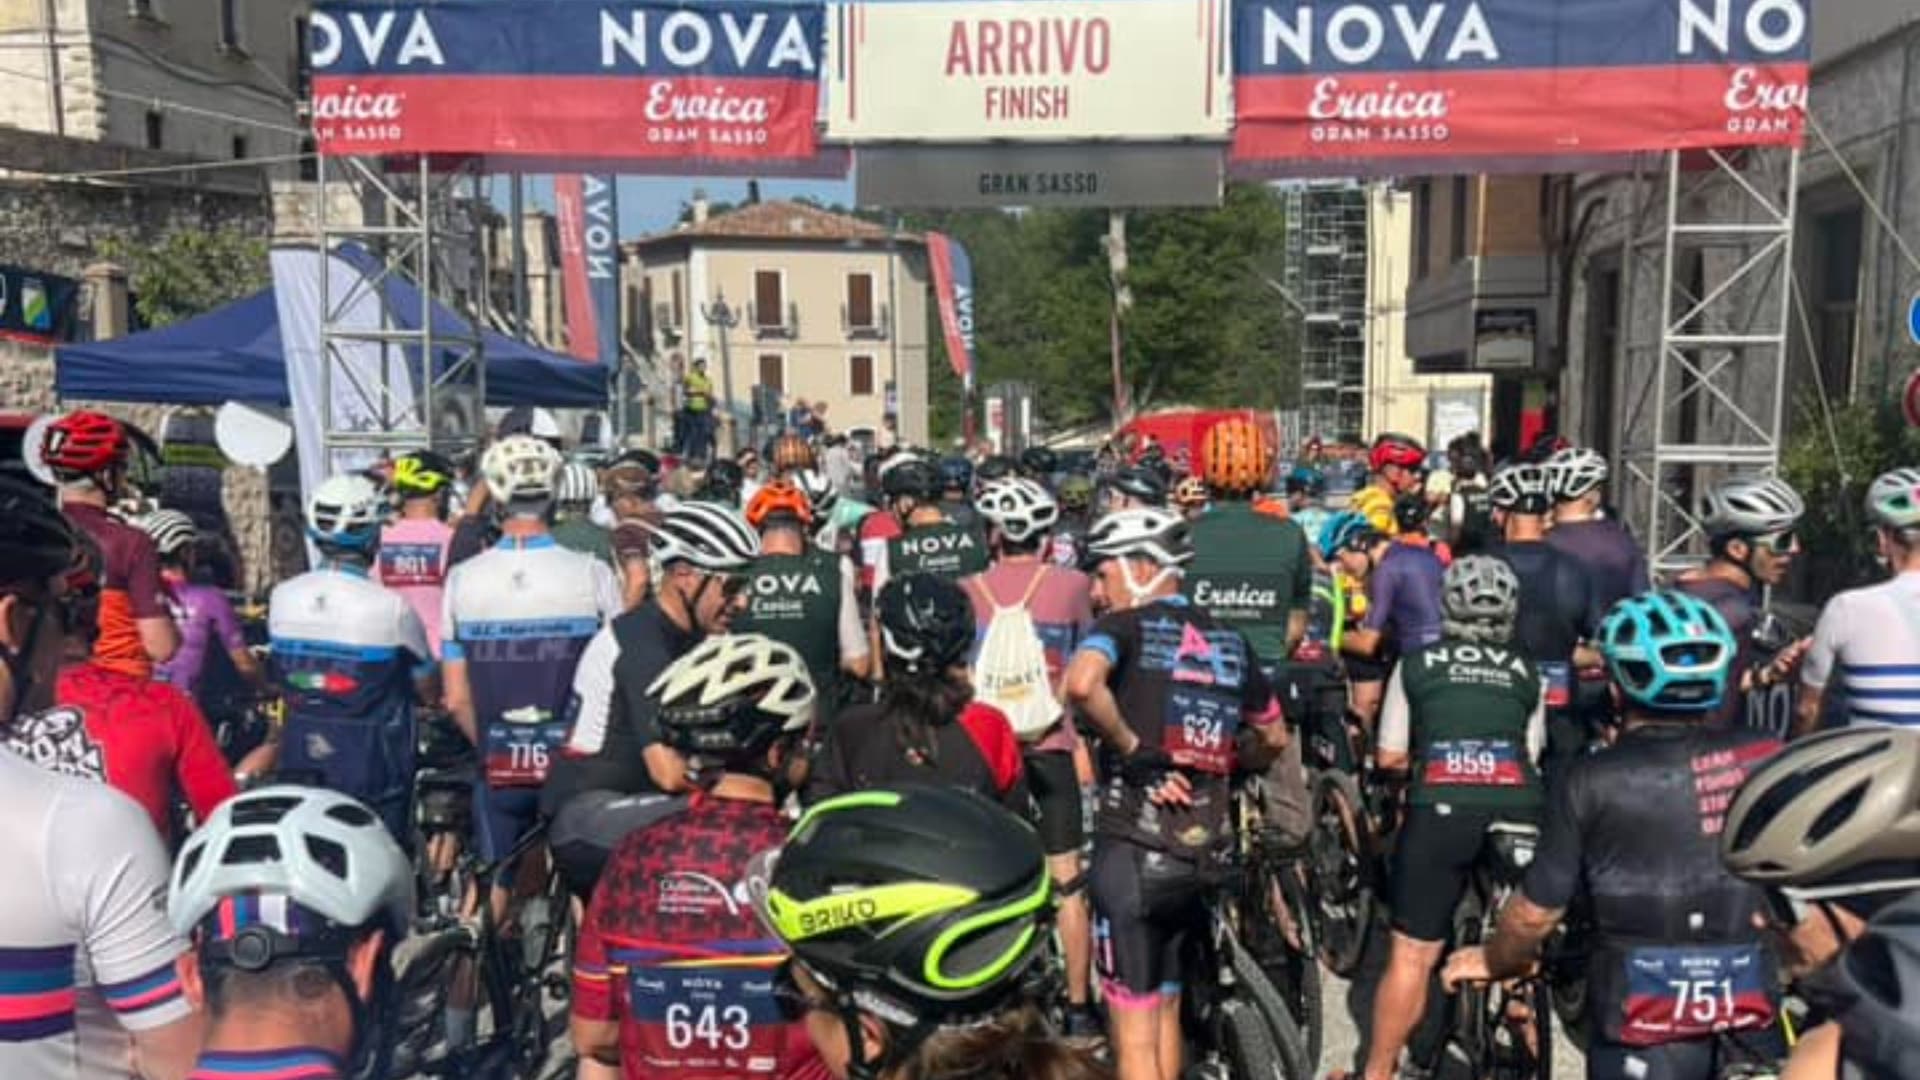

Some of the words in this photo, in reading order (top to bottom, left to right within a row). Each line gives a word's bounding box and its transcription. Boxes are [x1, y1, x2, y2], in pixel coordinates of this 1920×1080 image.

[311, 10, 444, 66] OVA
[601, 10, 814, 69] NOVA
[1262, 2, 1499, 65] NOVA
[1676, 0, 1806, 53] NO
[945, 18, 1111, 76] ARRIVO
[312, 85, 402, 119] oica
[644, 82, 769, 121] Eroica
[985, 86, 1069, 120] FINISH
[1308, 79, 1446, 119] Eroica
[1724, 66, 1808, 111] Ero
[647, 129, 698, 142] GRAN
[709, 129, 767, 144] SASSO
[1311, 126, 1370, 141] GRAN
[1383, 124, 1448, 140] SASSO
[1727, 117, 1788, 133] GRAN
[978, 174, 1028, 195] GRAN
[1037, 173, 1098, 194] SASSO
[902, 533, 975, 555] NOVA
[746, 573, 822, 595] OVA
[1194, 580, 1276, 606] Eroica
[1424, 645, 1528, 679] NOVA
[507, 742, 549, 769] 776
[1446, 750, 1495, 775] 859
[1669, 979, 1734, 1023] 751
[665, 1002, 750, 1050] 643
